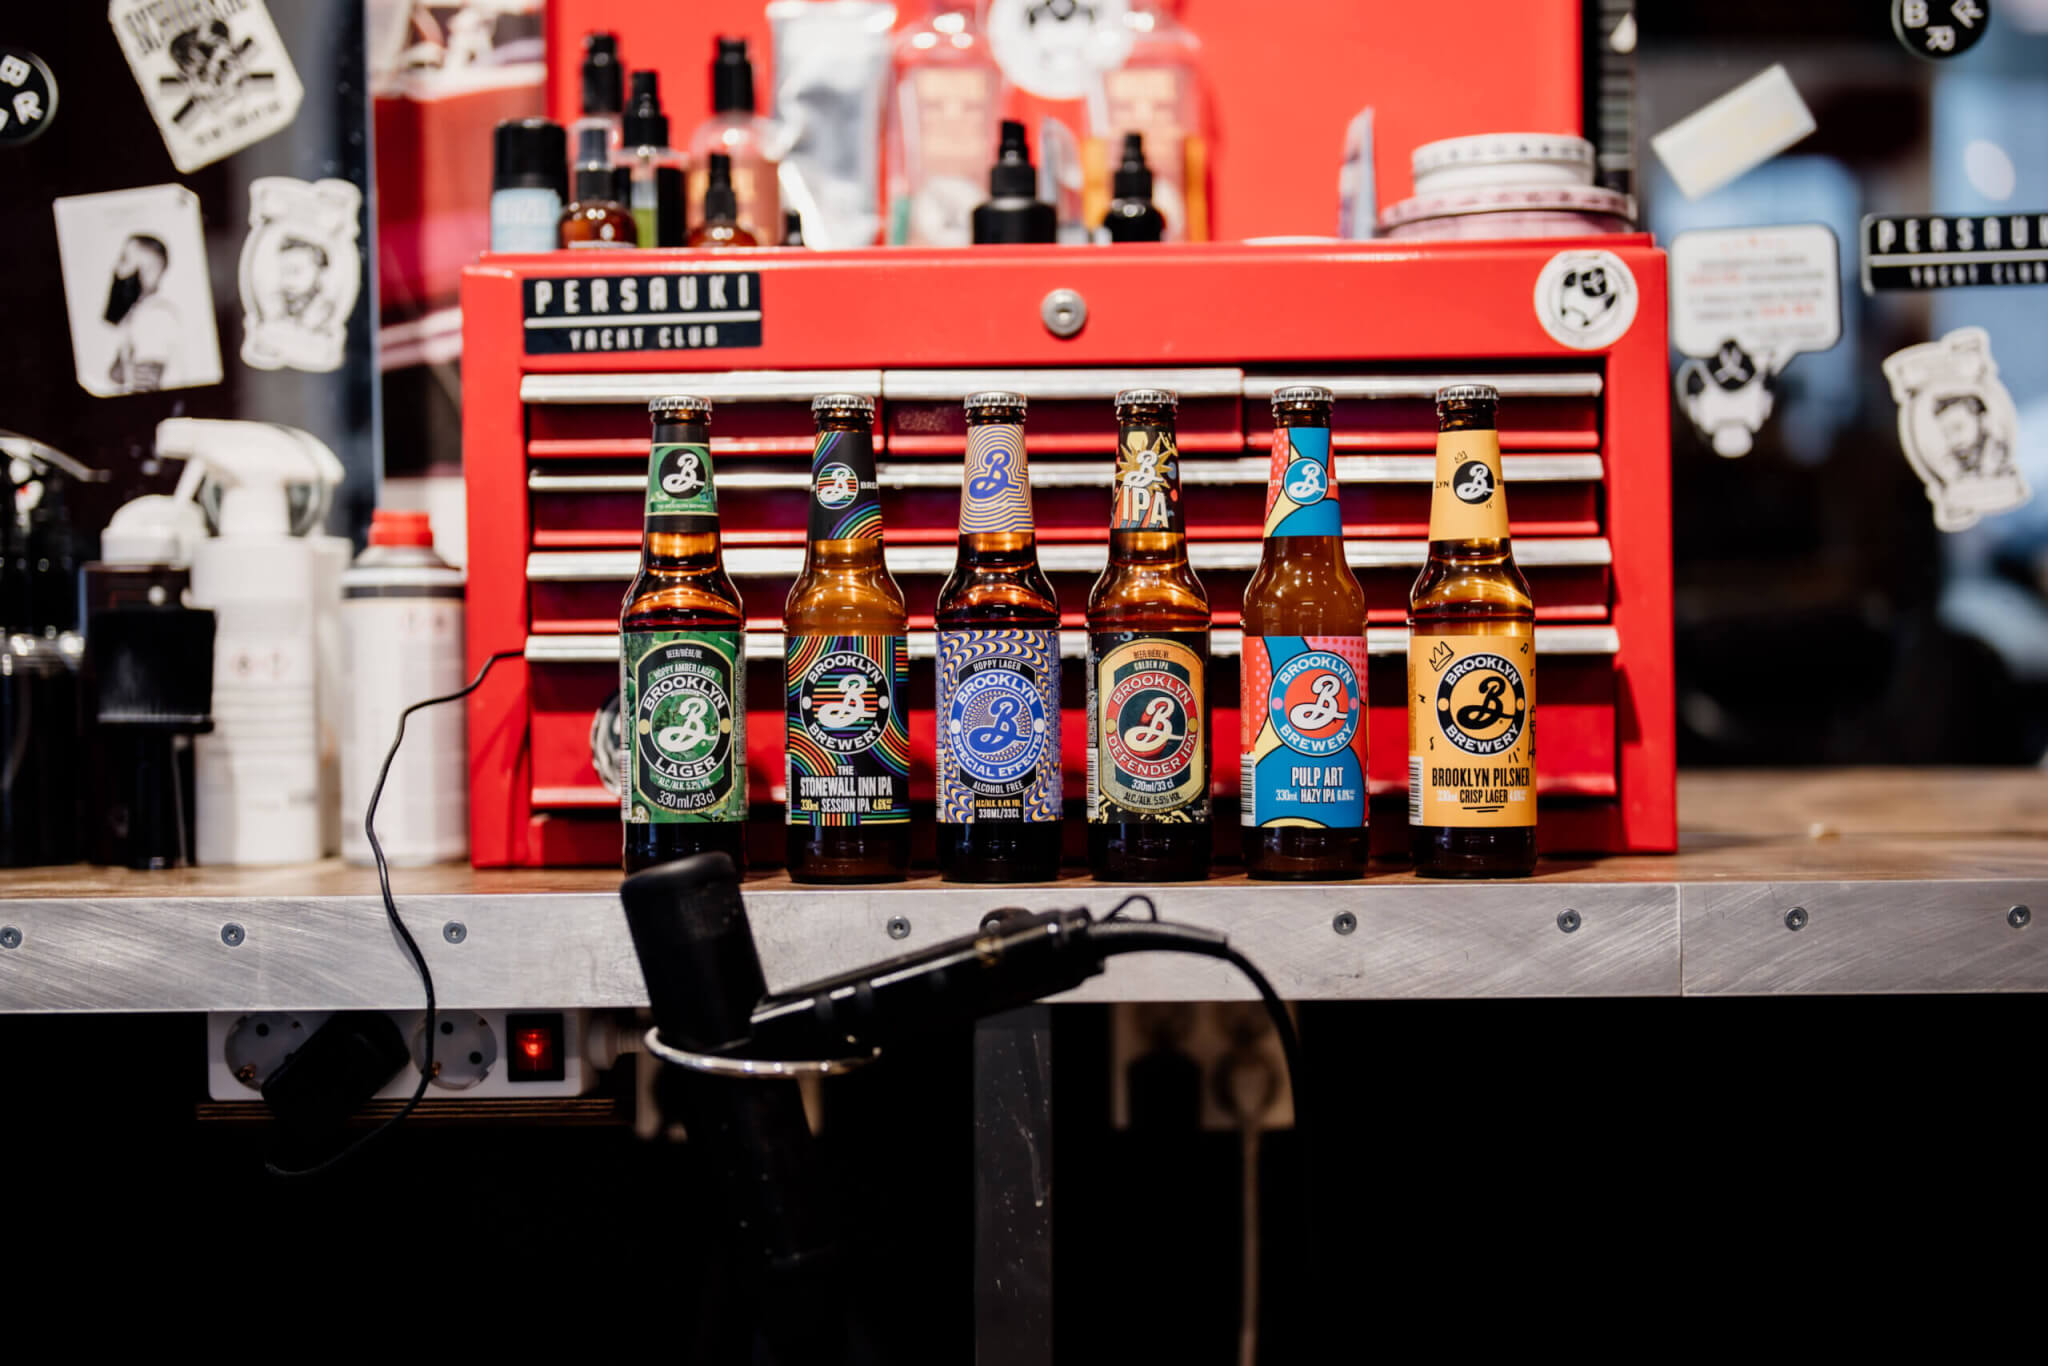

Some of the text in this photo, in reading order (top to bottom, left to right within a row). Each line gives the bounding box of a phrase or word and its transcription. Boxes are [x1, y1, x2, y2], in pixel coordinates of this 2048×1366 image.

[535, 273, 749, 315] PERSAUKI
[570, 324, 718, 351] YACHT CLUB
[1121, 485, 1169, 528] IPA
[654, 663, 717, 679] HOPPY AMBER LAGER
[808, 655, 882, 684] BROOKLYN
[973, 658, 1021, 672] HOPPY LAGER
[1279, 656, 1354, 685] BROOKLYN
[1445, 657, 1519, 686] BROOKLYN
[643, 676, 726, 711] BROOKLYN
[956, 674, 1038, 705] BROOKLYN
[1112, 674, 1192, 705] BROOKLYN
[808, 721, 881, 750] BREWERY
[1280, 723, 1352, 752] BREWERY
[1446, 723, 1518, 752] BREWERY
[655, 756, 717, 777] LAGER
[953, 734, 1043, 777] SPECIAL EFFECTS
[1108, 734, 1197, 776] DEFENDER IPA
[837, 765, 855, 776] THE
[1291, 767, 1344, 787] PULP ART
[1432, 768, 1530, 787] BROOKLYN PILSNER
[800, 776, 893, 797] STONEWALL INN IPA
[972, 780, 1024, 794] ALCOHOL FREE
[1300, 789, 1321, 803] HAZY
[1322, 789, 1336, 803] IPA
[1459, 789, 1483, 803] CRISP
[1485, 789, 1508, 803] LAGER
[821, 798, 856, 813] SESSION
[857, 798, 871, 813] IPA
